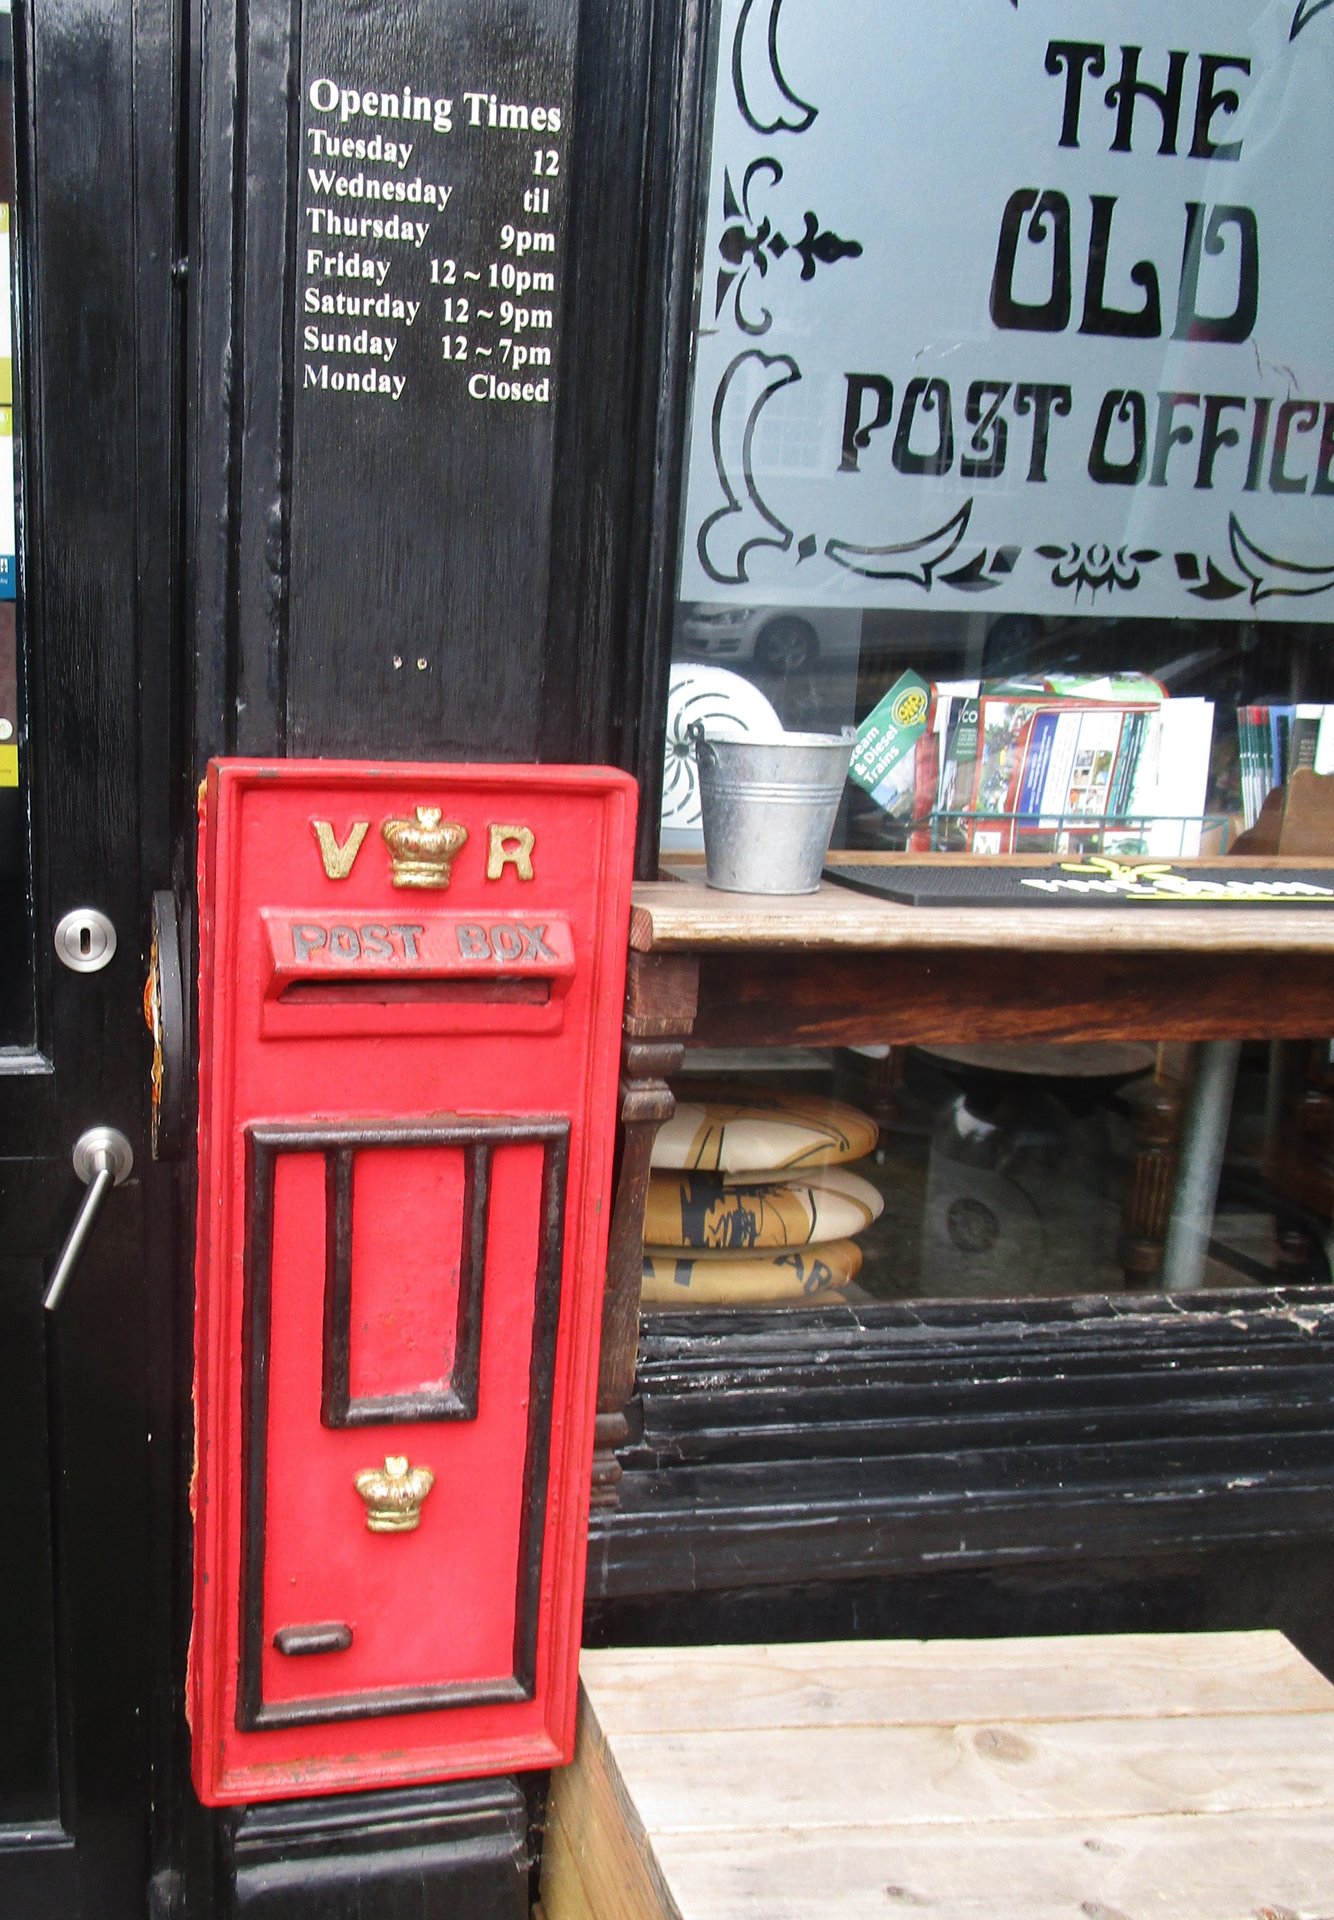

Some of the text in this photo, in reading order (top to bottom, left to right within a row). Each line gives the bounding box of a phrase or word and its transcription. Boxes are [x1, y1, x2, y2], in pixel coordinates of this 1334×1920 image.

[308, 77, 561, 133] Opening Times
[1044, 39, 1251, 161] THE
[308, 127, 559, 176] Tuesday 12
[307, 167, 549, 213] Wednesday til
[306, 208, 554, 256] Thursday 9pm
[306, 249, 390, 286] Friday
[431, 259, 456, 284] 12
[489, 263, 554, 295] 10pm
[989, 187, 1259, 344] OLD
[304, 287, 420, 325] Saturday
[443, 298, 468, 323] 12
[500, 301, 552, 333] 9pm
[304, 326, 397, 362] Sunday
[442, 335, 467, 360] 12
[499, 339, 550, 370] 7pm
[303, 364, 549, 402] Monday Closed
[836, 372, 1072, 482] POST
[854, 724, 898, 776] & Diesel
[863, 746, 900, 784] Trains
[312, 820, 535, 881] V R
[291, 922, 558, 964] POST BOX
